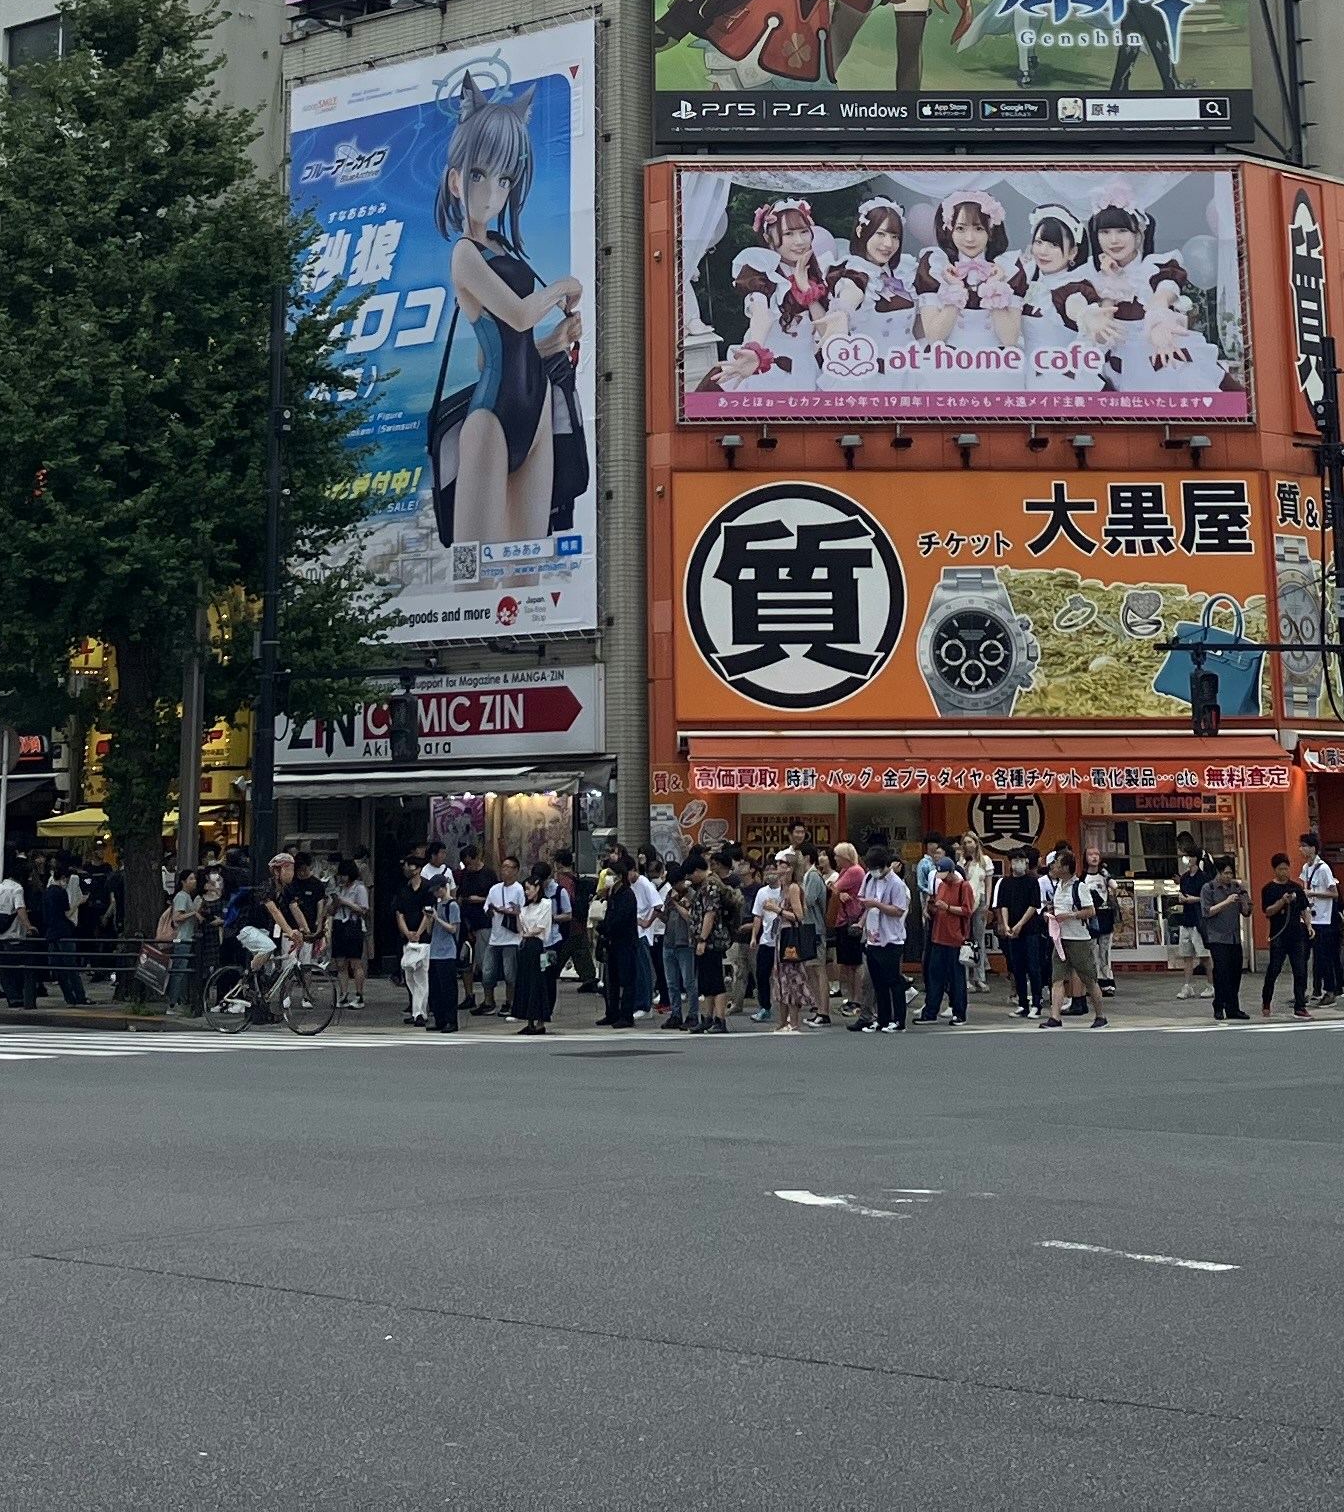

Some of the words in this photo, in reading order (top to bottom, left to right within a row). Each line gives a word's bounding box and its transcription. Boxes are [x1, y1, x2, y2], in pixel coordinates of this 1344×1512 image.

[1020, 30, 1143, 48] Genshin
[702, 102, 756, 118] PS5
[773, 102, 828, 118] PS4
[839, 102, 909, 119] Windows
[328, 202, 387, 223] すなおおかみ
[889, 347, 1021, 372] at-home
[1033, 346, 1101, 372] cafe
[377, 411, 404, 422] Figure
[387, 500, 420, 513] SALE!
[1023, 481, 1255, 558] 大黒屋
[502, 544, 541, 558] あみあみ
[918, 532, 1012, 558] チケット
[711, 516, 885, 680] 質
[409, 610, 439, 628] goods
[441, 608, 460, 624] and
[463, 607, 492, 622] more
[410, 676, 444, 691] upport
[445, 674, 456, 687] for
[459, 674, 501, 688] Magazine
[511, 670, 565, 683] MANGA-ZIN
[478, 692, 525, 731] ZIN
[693, 766, 780, 790] 高価買取
[1204, 766, 1290, 789] 無料査定
[1134, 793, 1202, 810] Exchange
